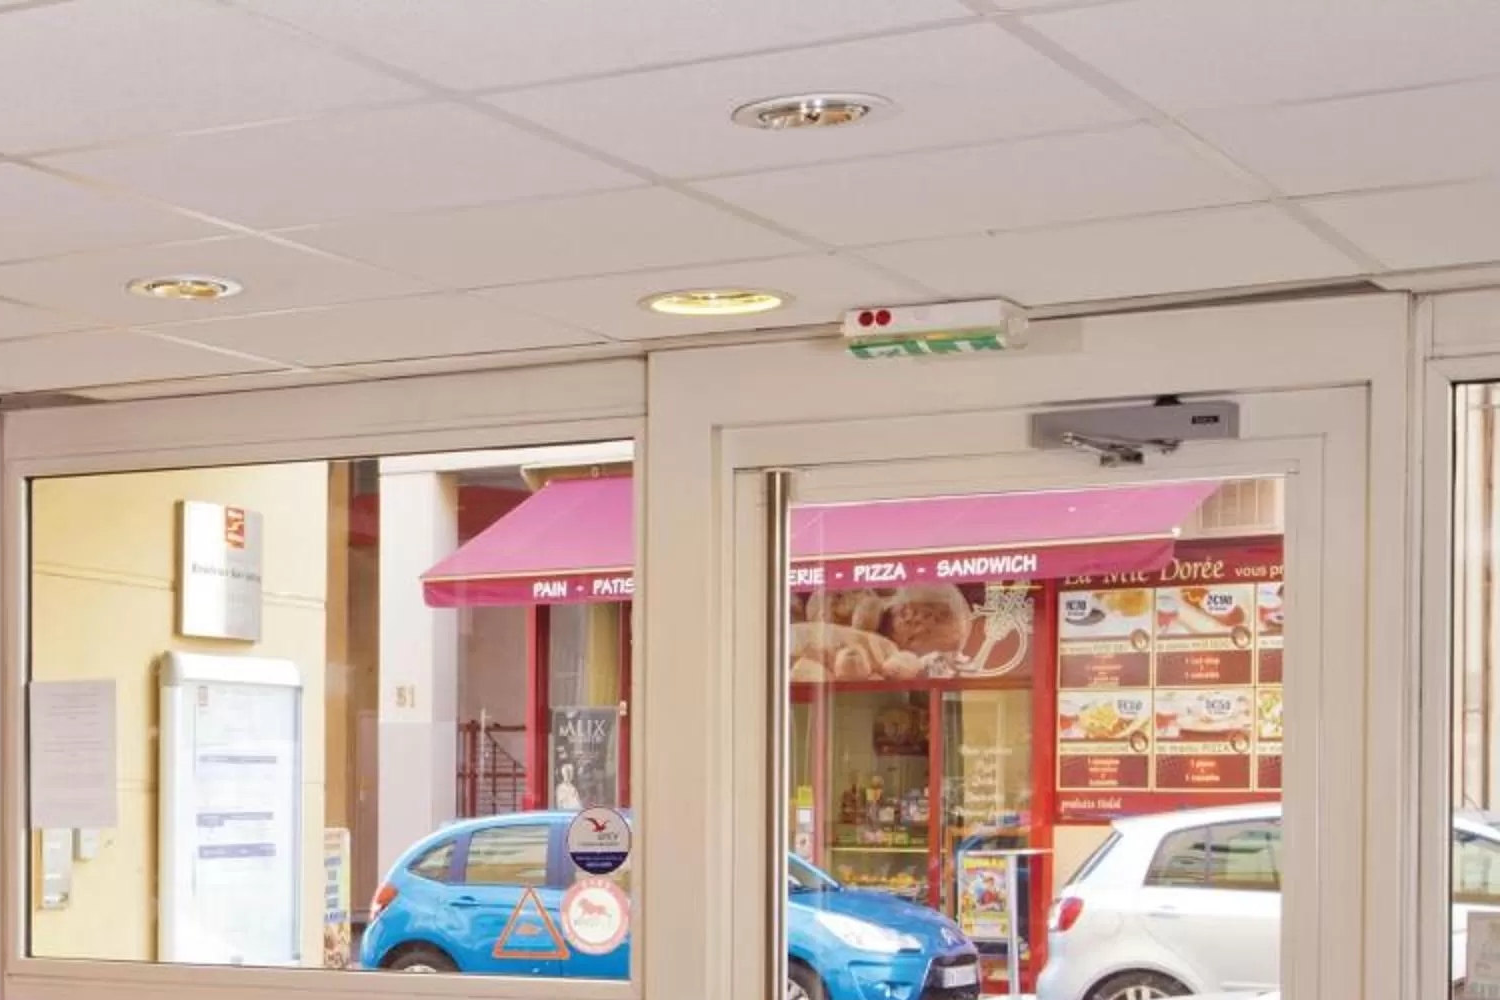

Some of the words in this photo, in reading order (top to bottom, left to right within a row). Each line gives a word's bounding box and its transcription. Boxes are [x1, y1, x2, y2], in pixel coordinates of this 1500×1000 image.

[533, 580, 568, 598] PAIN
[592, 577, 636, 595] PATIS
[788, 567, 825, 586] ERIE
[853, 562, 907, 583] PIZZA
[936, 554, 1038, 578] SANDWICH
[1159, 556, 1225, 582] Dorée
[1234, 566, 1267, 578] vous
